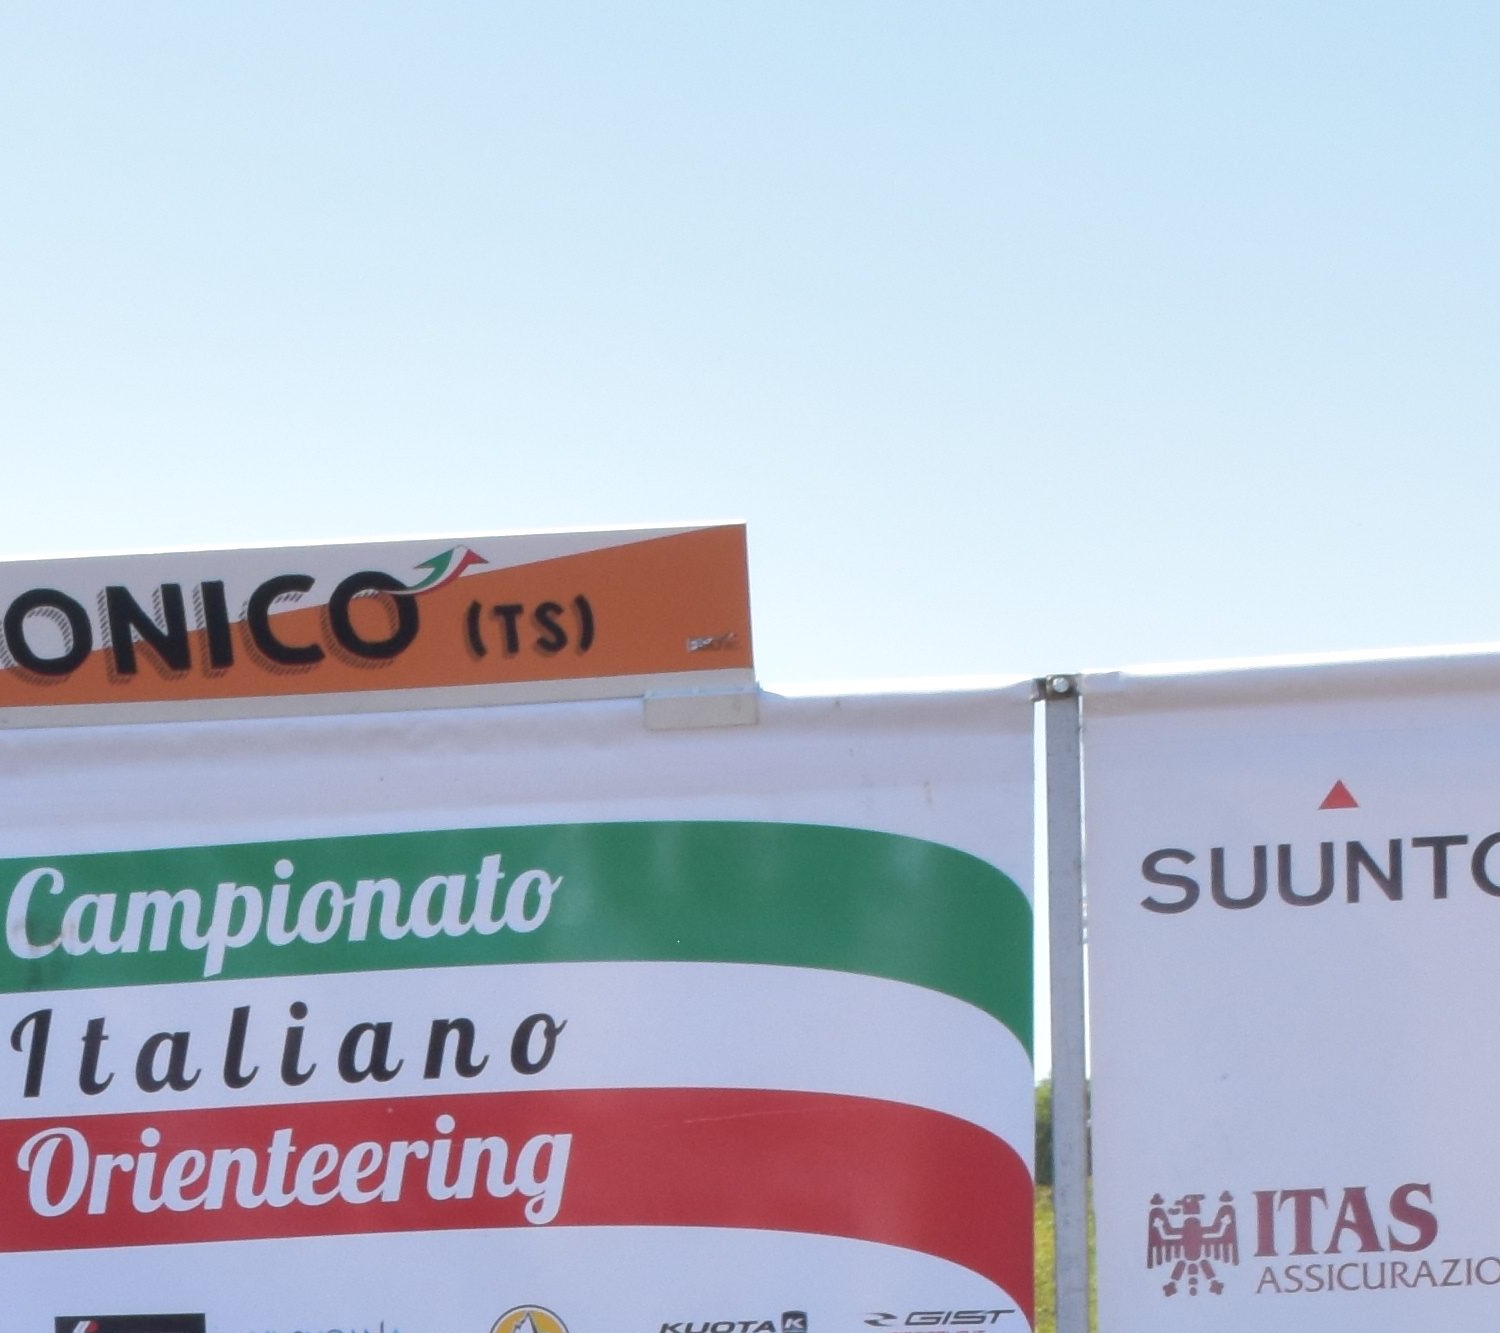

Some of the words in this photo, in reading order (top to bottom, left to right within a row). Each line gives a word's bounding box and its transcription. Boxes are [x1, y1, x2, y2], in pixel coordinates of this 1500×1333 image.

[466, 595, 596, 658] (TS)
[5, 853, 563, 978] Campionato
[10, 1000, 566, 1098] Italiano
[17, 1114, 576, 1225] Orienteering
[1253, 1182, 1438, 1258] ITAS
[905, 1309, 1015, 1326] GIST
